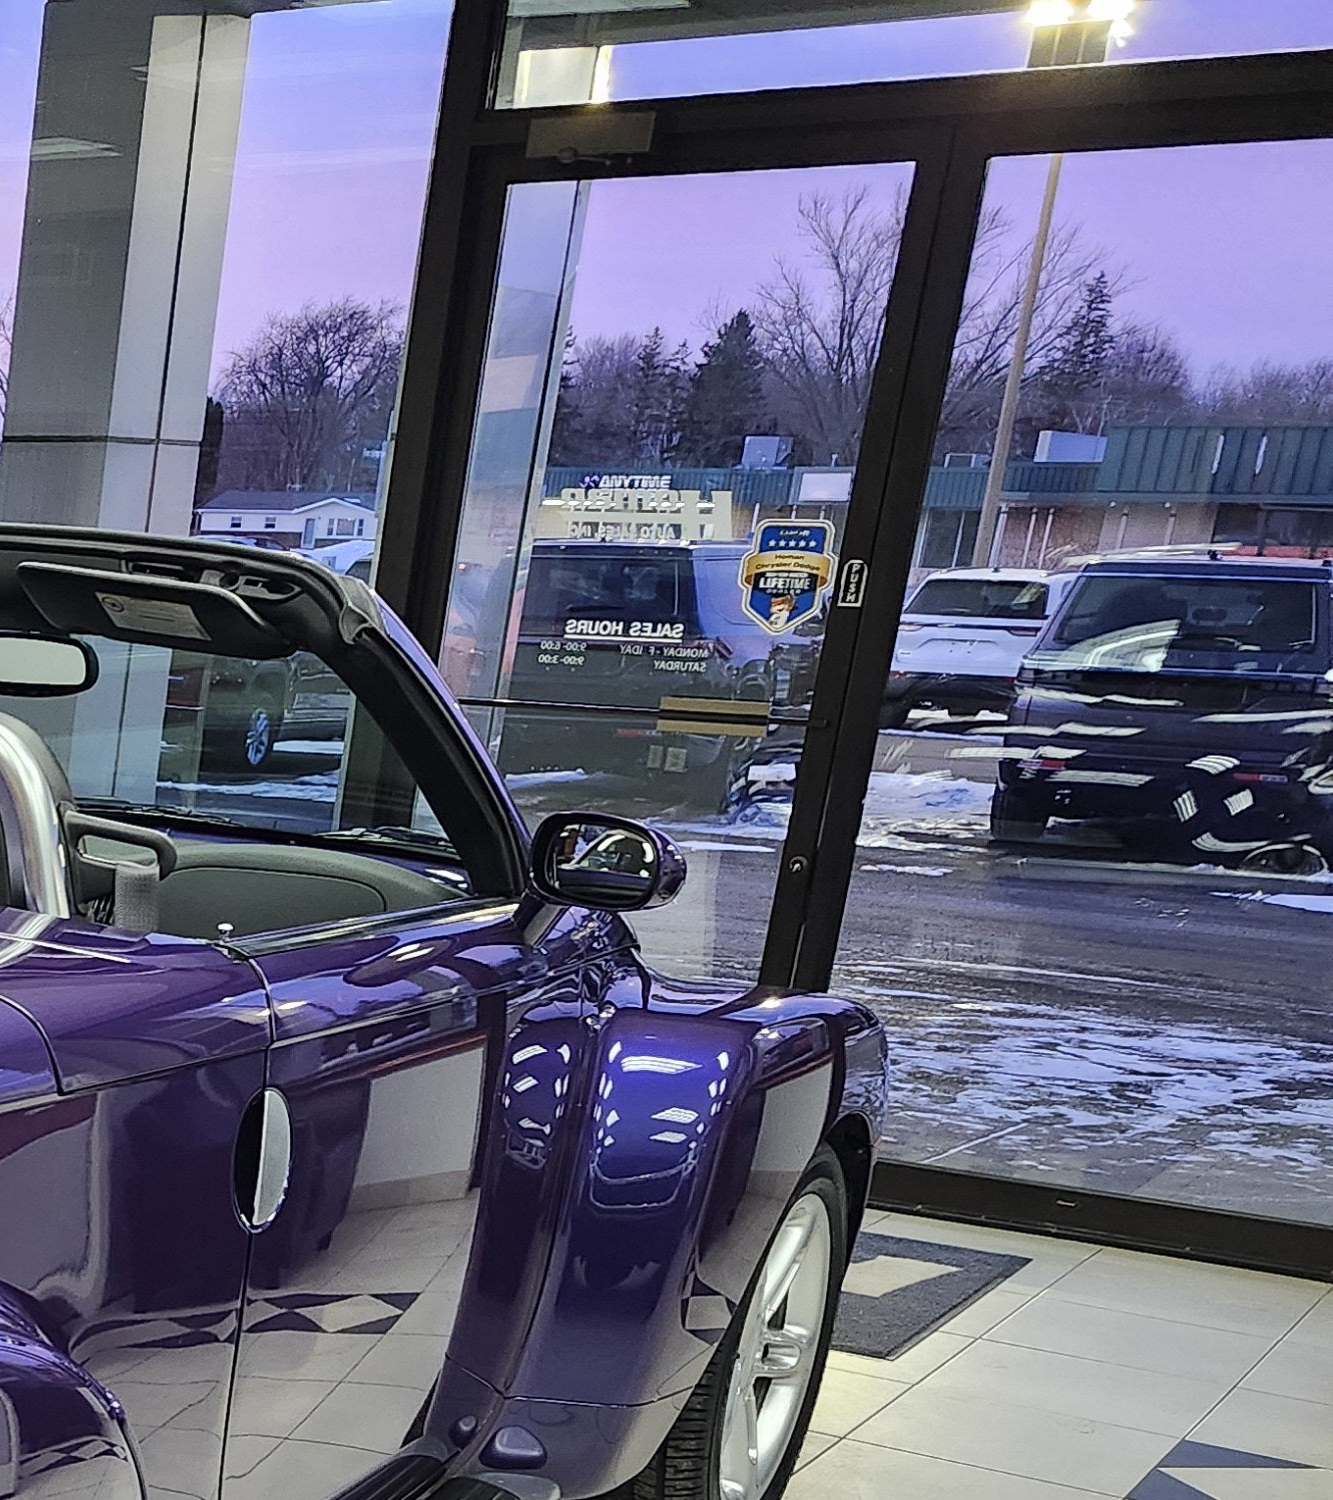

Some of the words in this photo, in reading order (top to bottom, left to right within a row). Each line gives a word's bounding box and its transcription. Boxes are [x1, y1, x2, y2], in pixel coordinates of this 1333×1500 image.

[598, 475, 672, 488] ANYTIME
[758, 577, 811, 590] LIFETIME
[845, 563, 862, 603] PUSH
